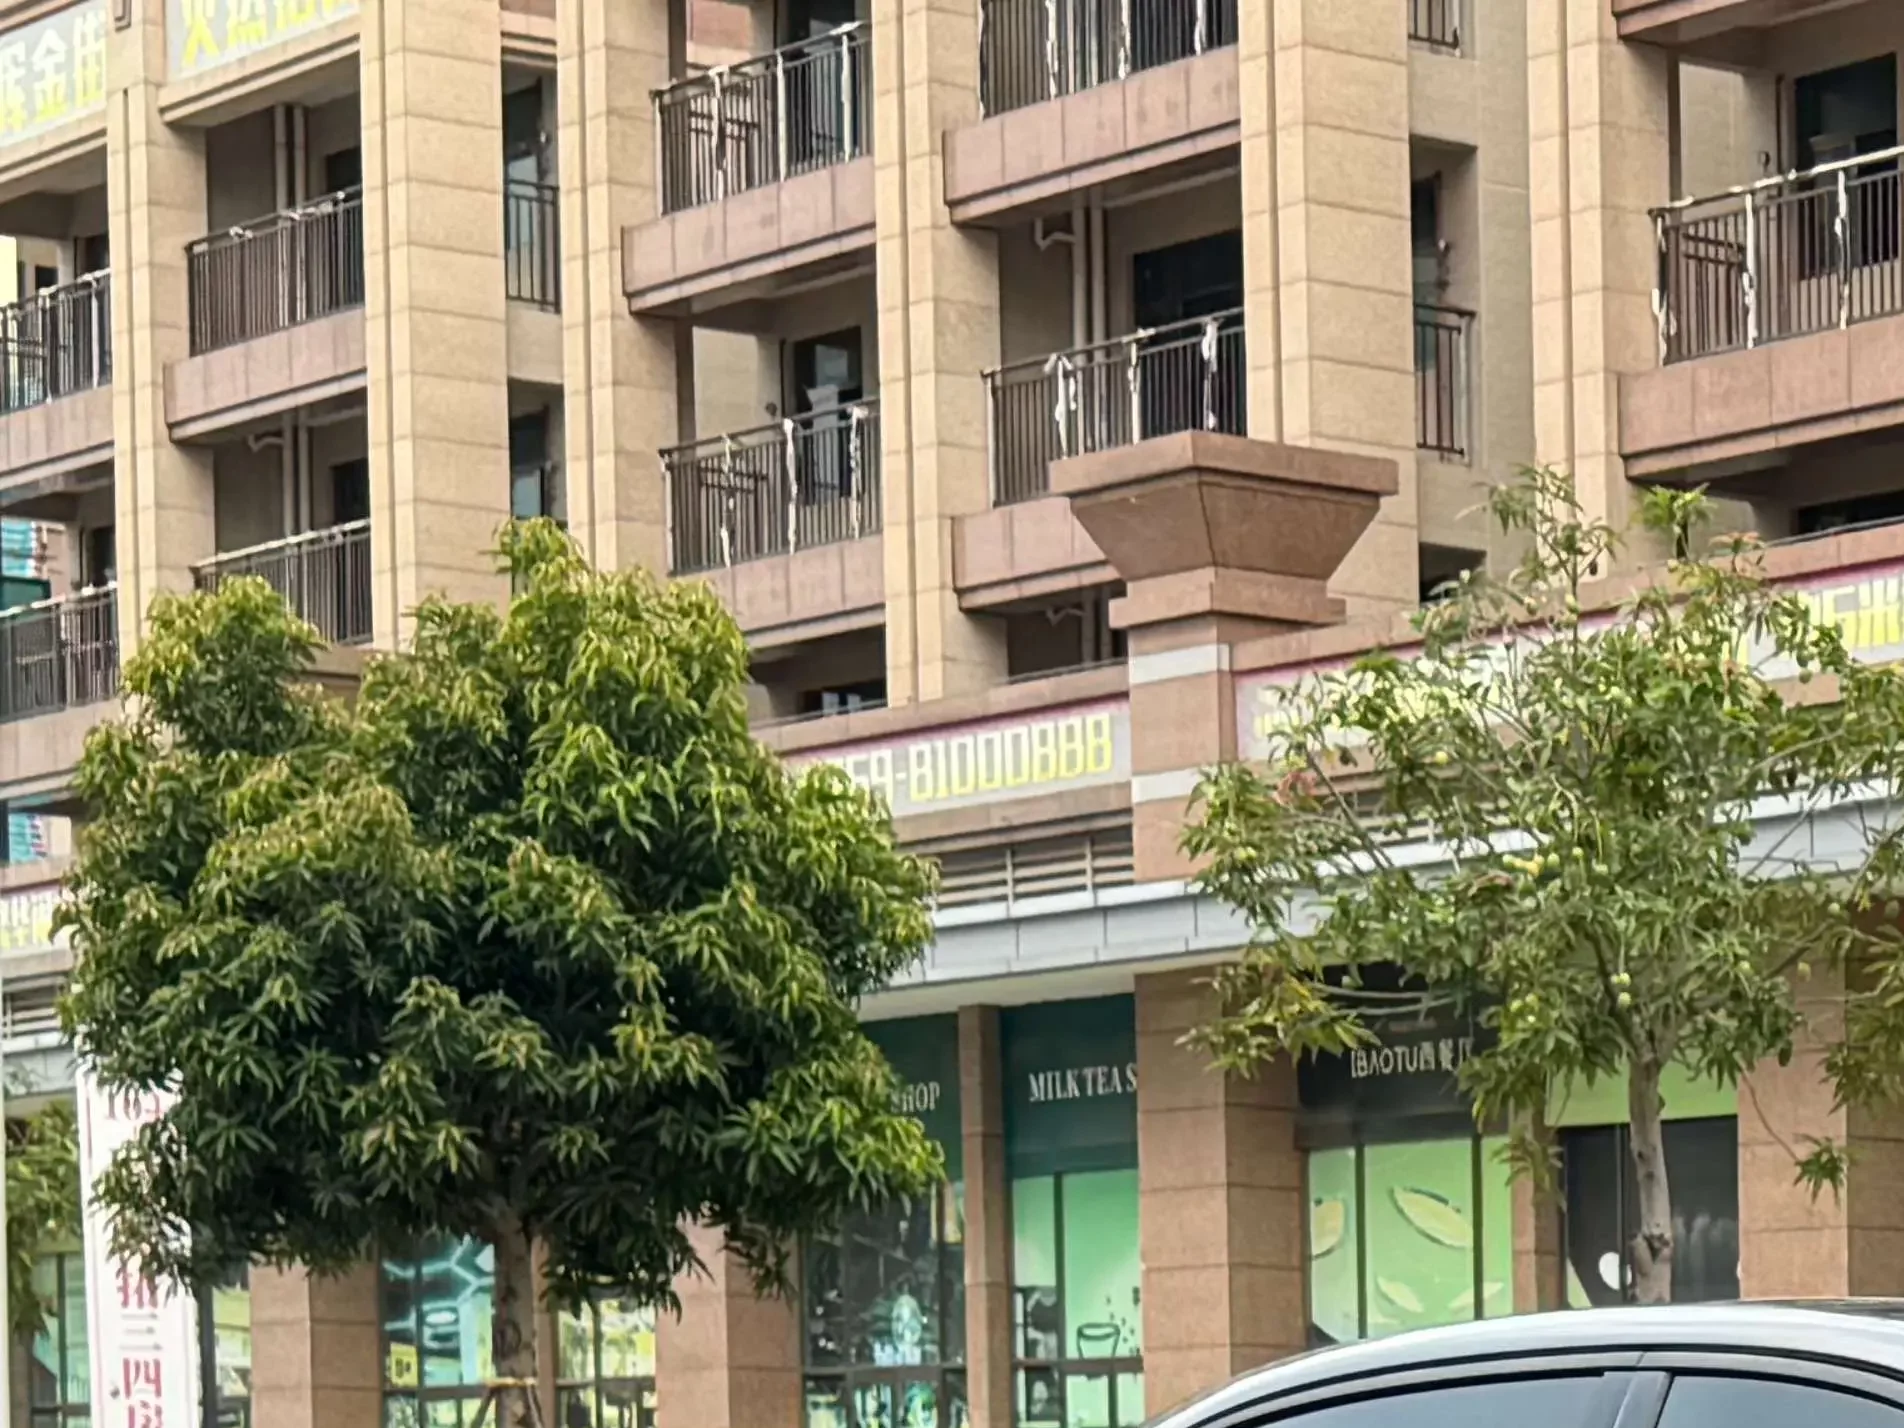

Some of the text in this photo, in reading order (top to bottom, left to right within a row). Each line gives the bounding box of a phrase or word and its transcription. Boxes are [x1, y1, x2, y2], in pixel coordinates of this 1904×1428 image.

[822, 713, 1112, 815] 69-81000888
[1029, 1070, 1080, 1103] MILK
[1081, 1064, 1122, 1097] TEA
